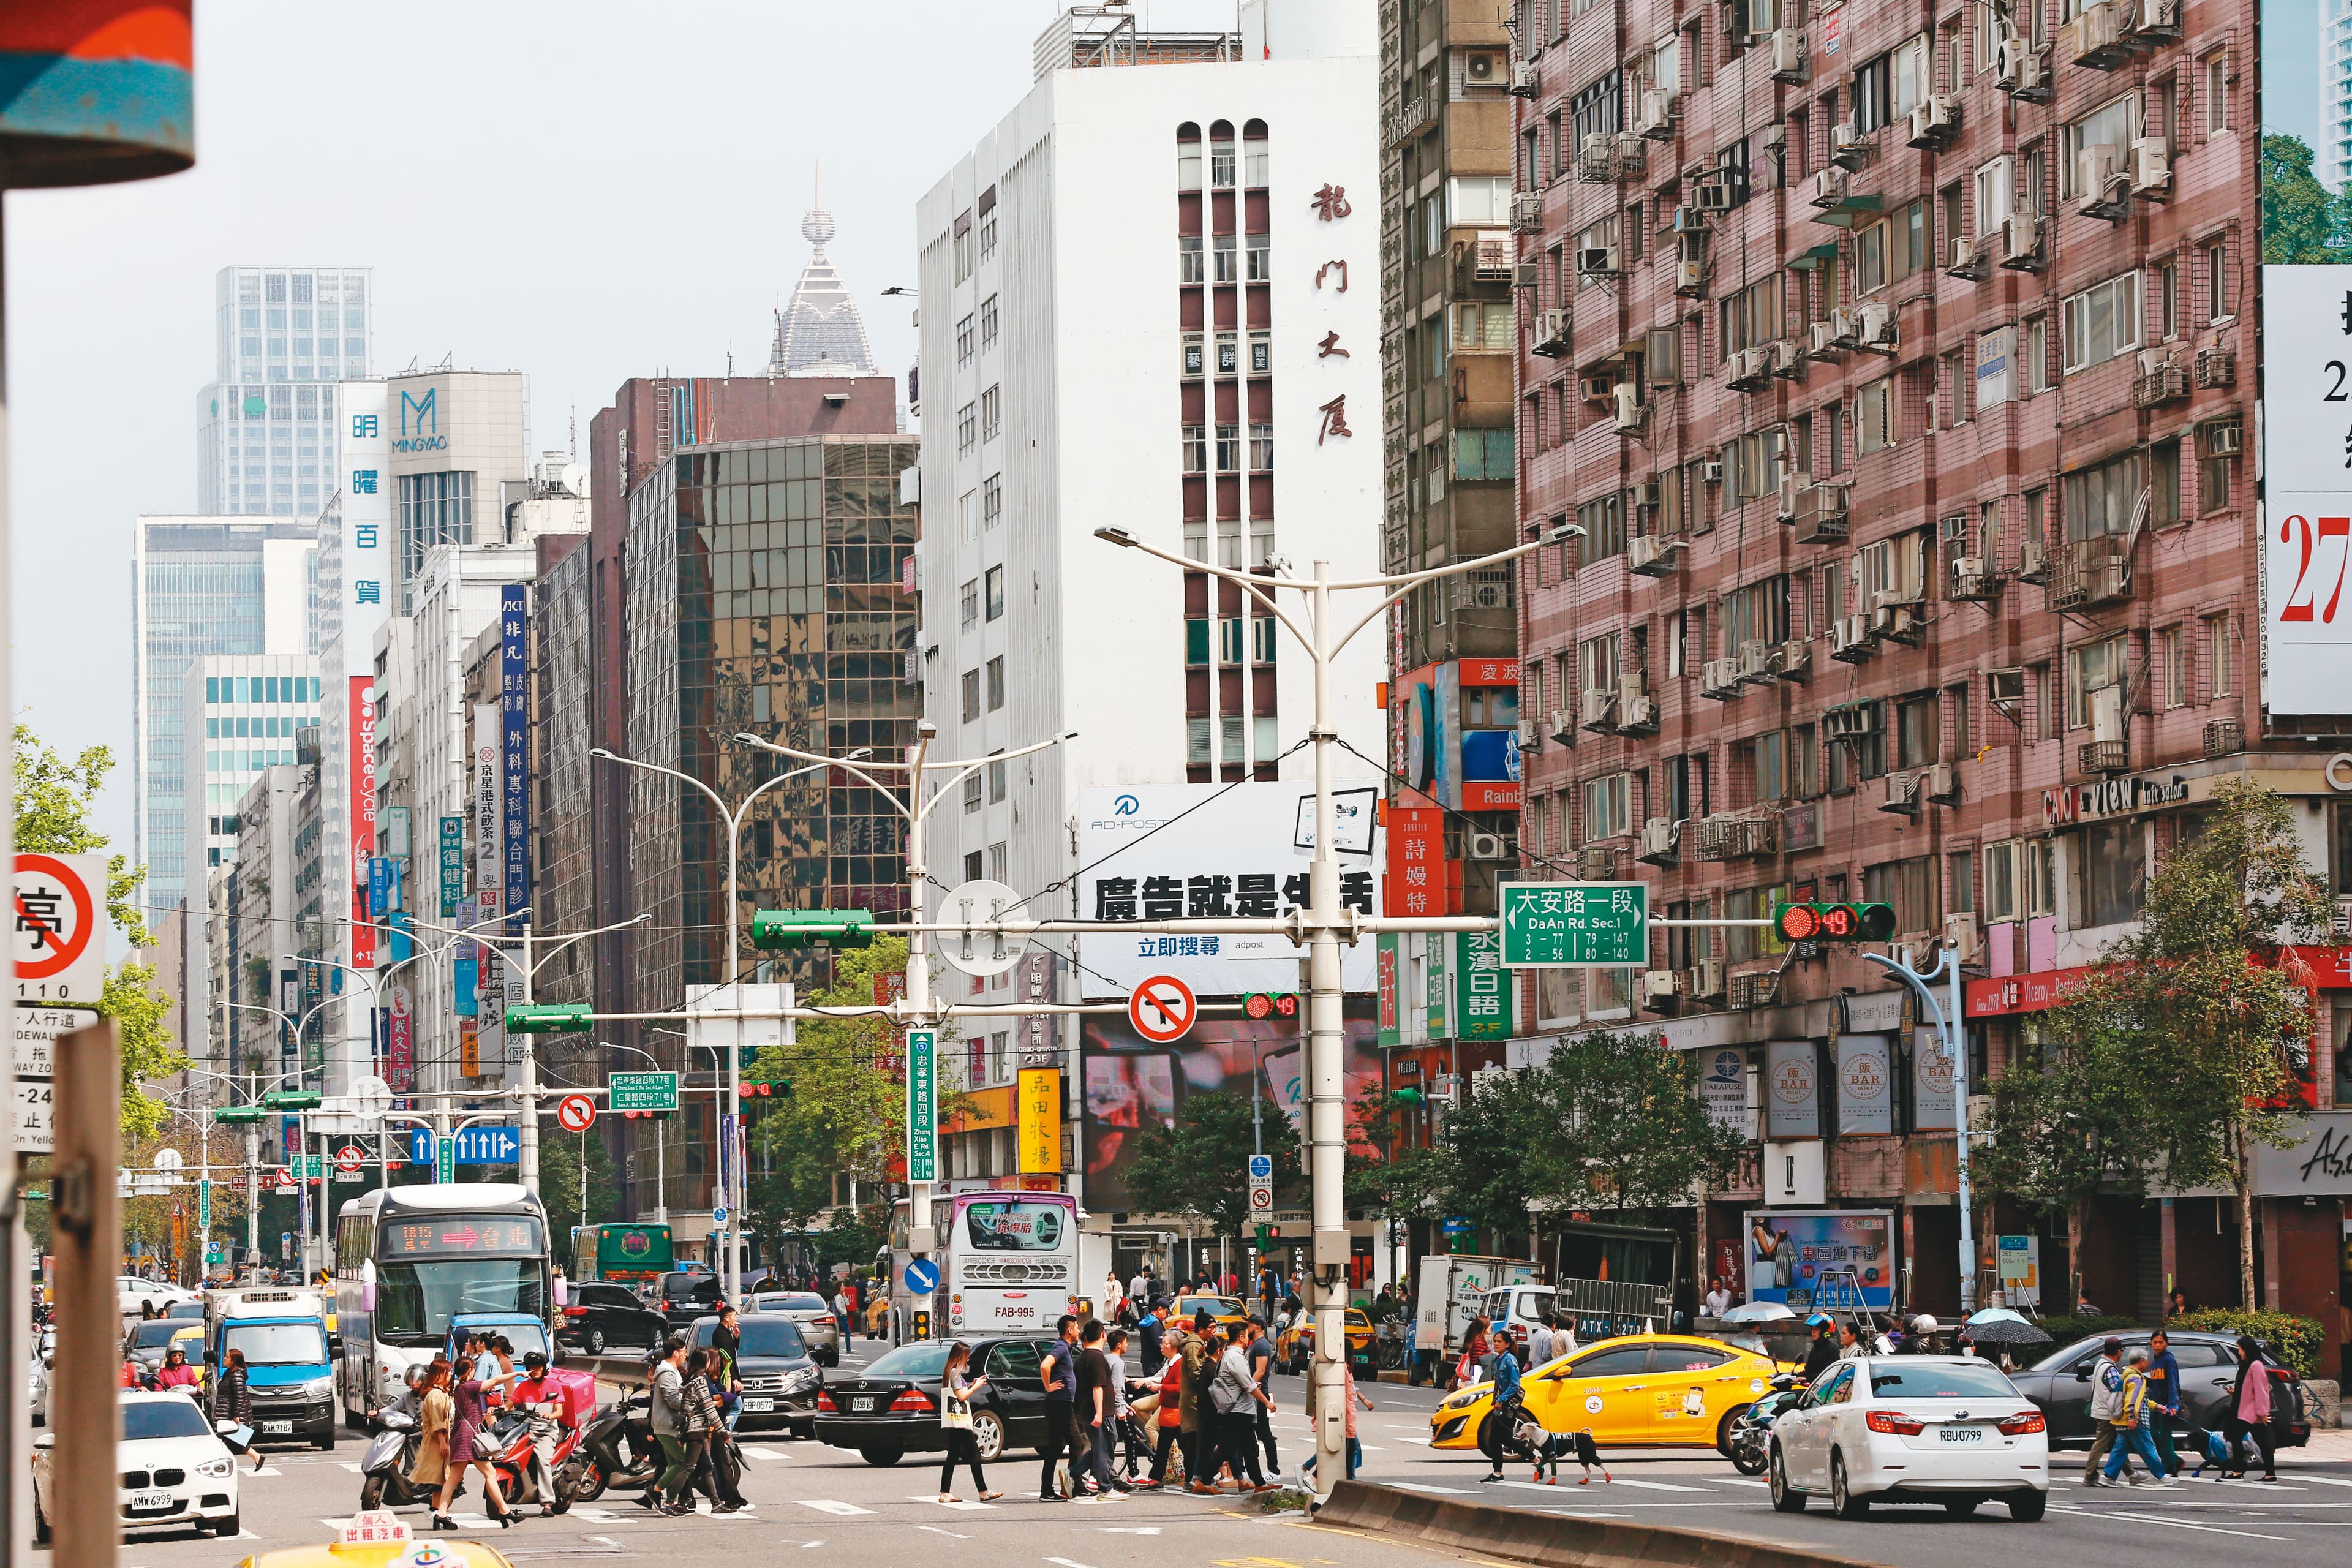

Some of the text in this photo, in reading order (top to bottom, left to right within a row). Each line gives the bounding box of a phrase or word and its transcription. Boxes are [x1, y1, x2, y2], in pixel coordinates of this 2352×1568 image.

[391, 435, 448, 454] MINGYAO
[352, 414, 380, 605] 明曜百貨
[505, 620, 522, 662] 非凡
[504, 674, 513, 712] 整形
[515, 674, 524, 712] 皮膚
[360, 720, 375, 823] SpaceCycle
[480, 764, 494, 840] 京星港式飲茶
[508, 730, 524, 906] 外科專科聯合門診
[1091, 819, 1169, 830] AD-POST
[443, 848, 461, 904] 復健科
[1404, 839, 1428, 914] 詩嫚特
[1517, 890, 1633, 914] 大安路一段
[1528, 917, 1621, 930] DaAn Rd. Sec.1
[1823, 910, 1847, 935] 49
[1137, 935, 1221, 958] 立即搜尋
[1235, 940, 1264, 950] adpost
[1526, 932, 1629, 945] 3 77 79 147
[1526, 948, 1629, 960] 2 56 80 140
[1468, 930, 1501, 1016] 永漢日語
[2024, 981, 2049, 1005] Viceroy
[1275, 997, 1295, 1016] 49
[1858, 1062, 1871, 1073] 飯
[1780, 1080, 1807, 1088] BAR
[1851, 1075, 1880, 1084] BAR
[617, 1092, 670, 1102] 仁愛路四段71巷
[916, 1055, 929, 1126] 忠孝東路四段
[1030, 1076, 1050, 1165] 品田牧場
[31, 1134, 55, 1144] Yello
[996, 1223, 1033, 1234] 抗爆胎
[1801, 1245, 1877, 1262] 東區地下街
[1792, 1290, 1806, 1299] 13
[995, 1306, 1035, 1317] FAB-995
[1940, 1429, 1983, 1443] RBU-0799
[361, 1514, 388, 1526] 個人
[346, 1526, 405, 1542] 出租汽車
